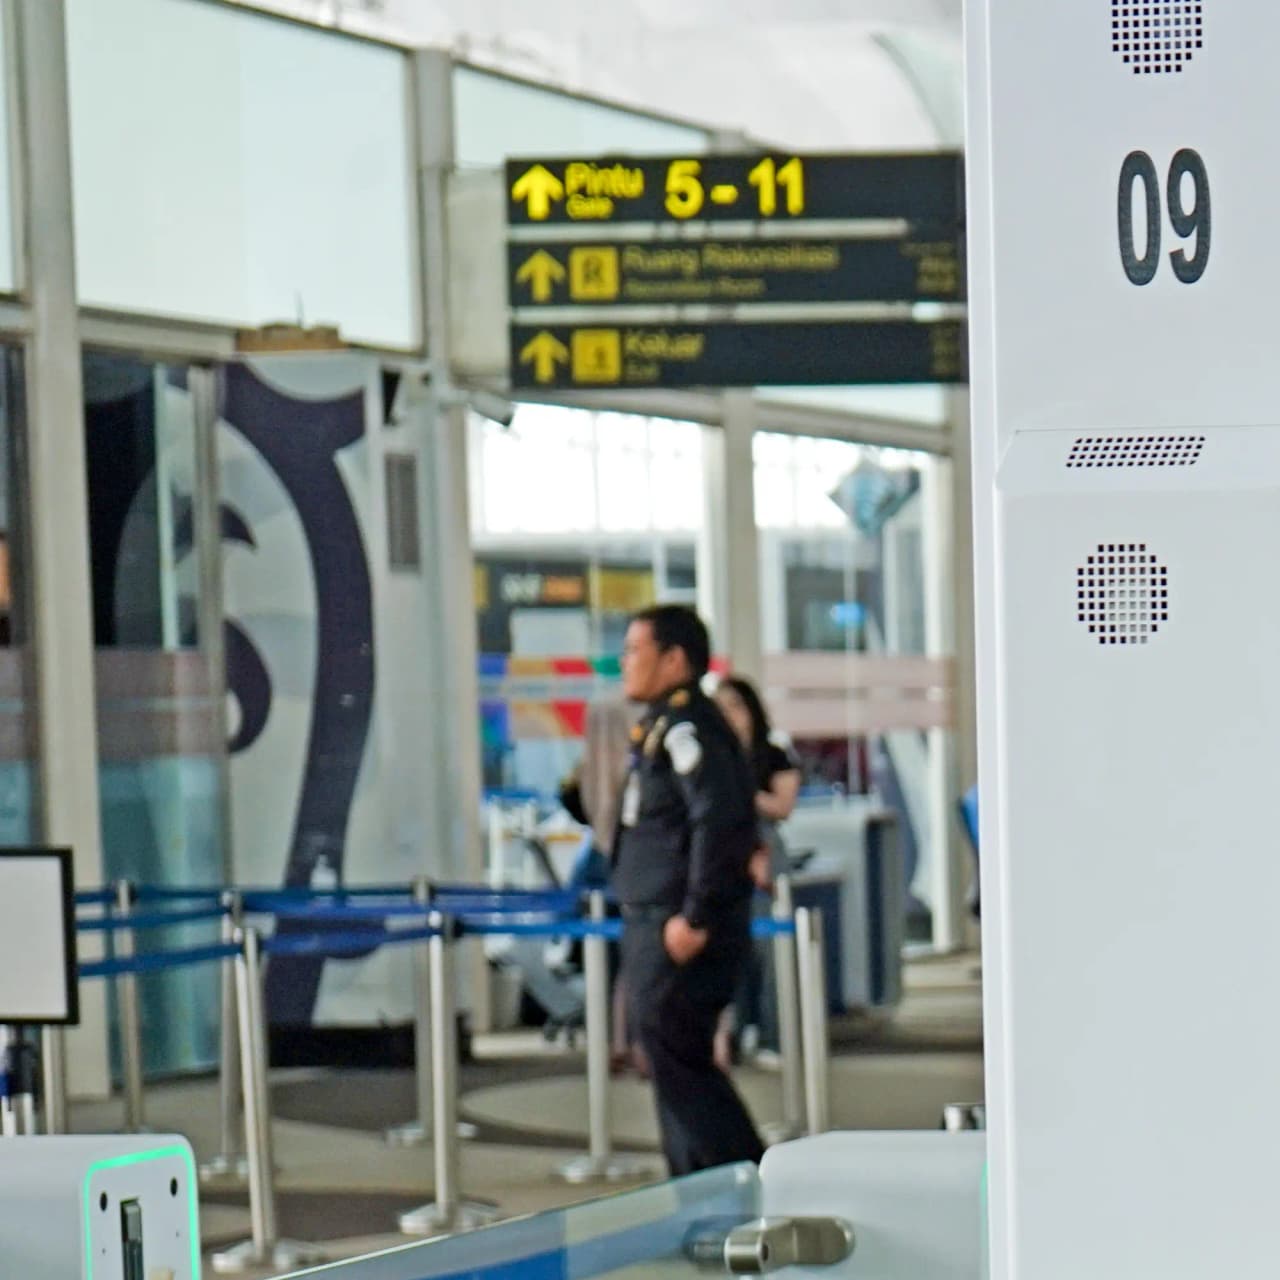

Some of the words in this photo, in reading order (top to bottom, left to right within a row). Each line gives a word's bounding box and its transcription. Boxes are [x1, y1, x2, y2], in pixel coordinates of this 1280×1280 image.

[564, 162, 645, 199] Pintu
[664, 158, 705, 219] 5
[748, 157, 804, 217] 11
[1116, 147, 1212, 287] 09
